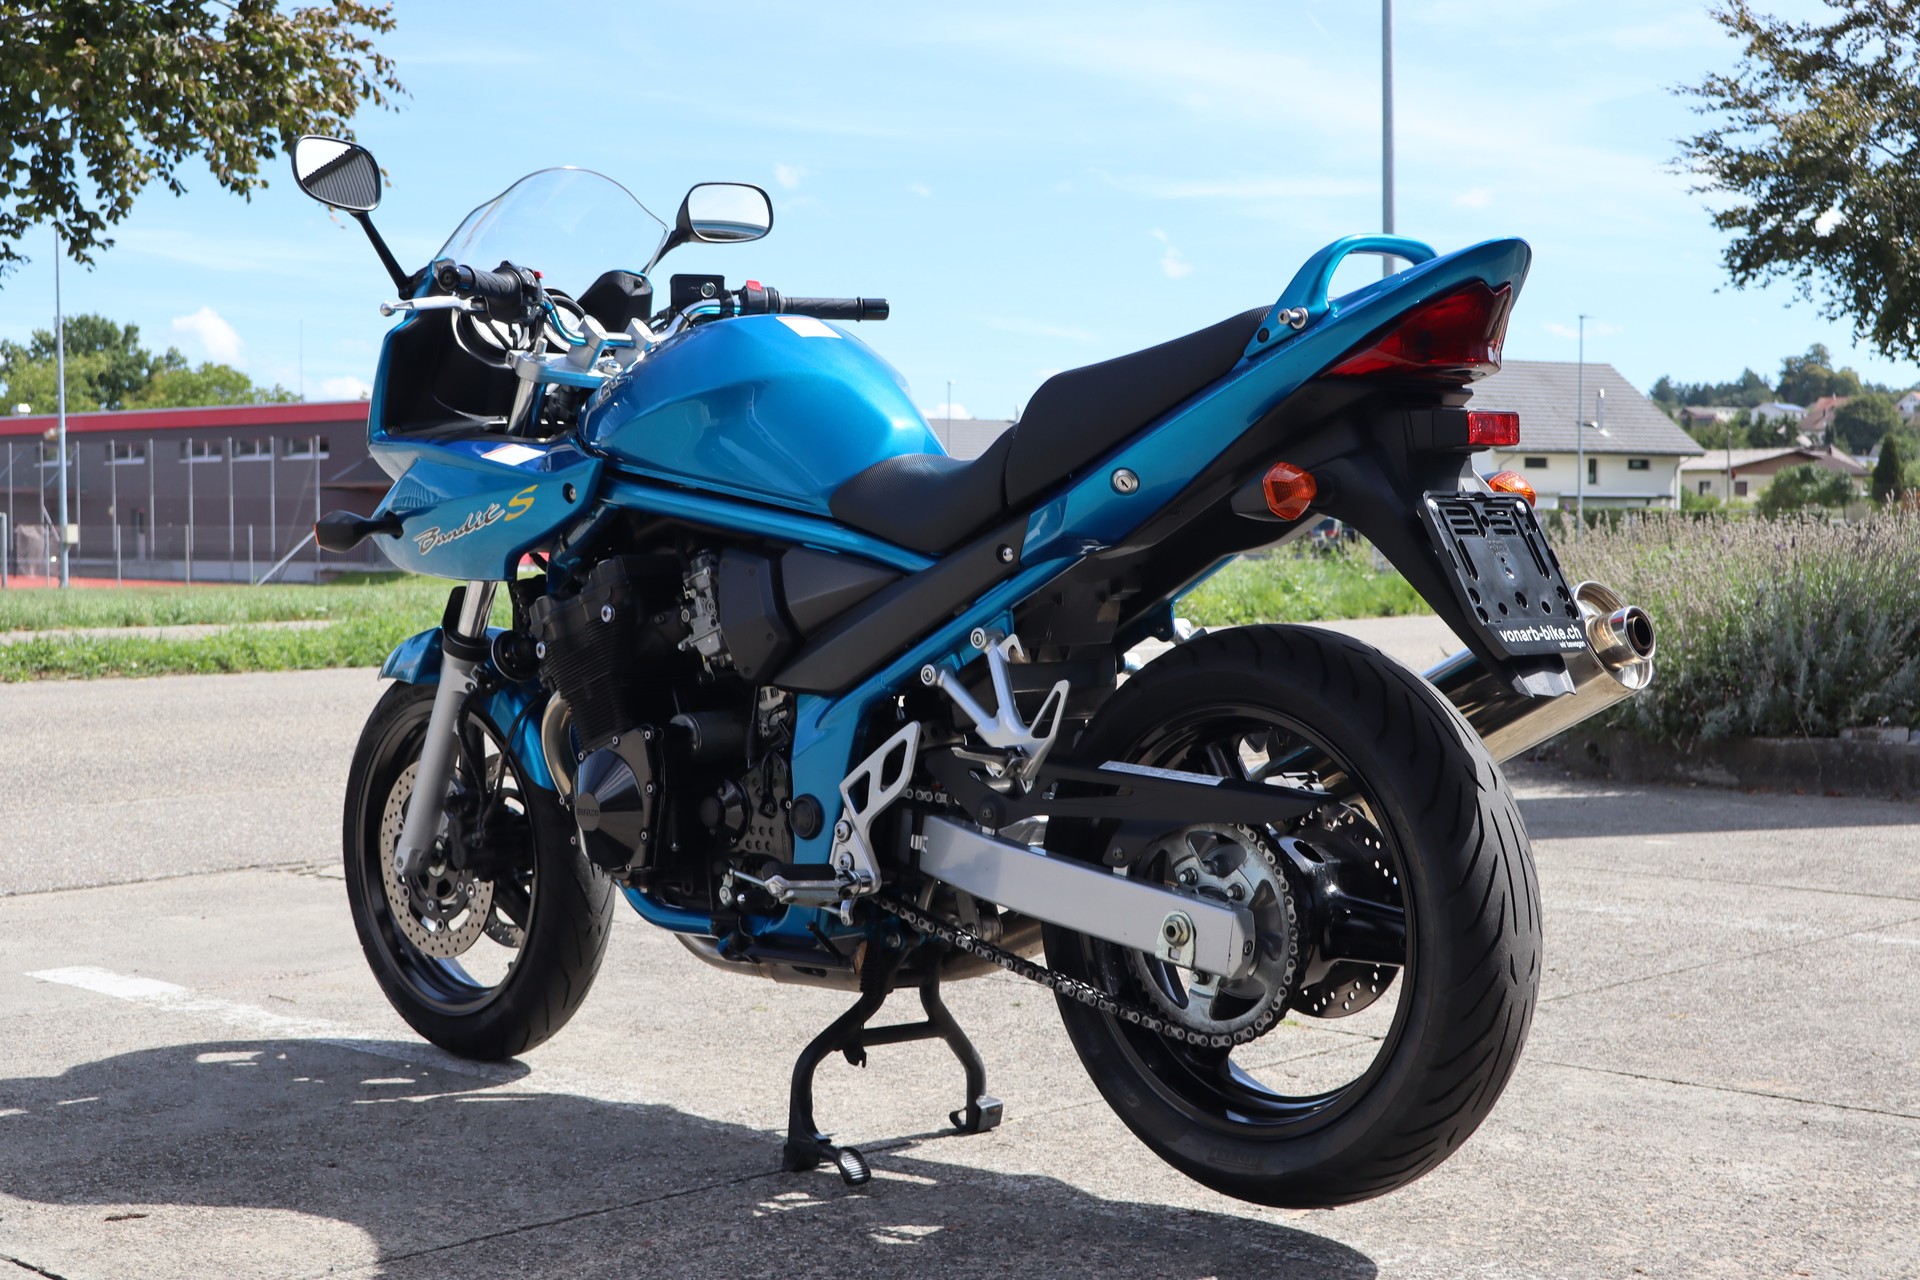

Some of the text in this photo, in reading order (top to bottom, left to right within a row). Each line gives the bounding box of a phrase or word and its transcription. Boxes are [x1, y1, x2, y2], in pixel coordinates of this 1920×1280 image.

[413, 484, 538, 556] Bandit S
[1499, 623, 1582, 643] vonarb-bike.ch
